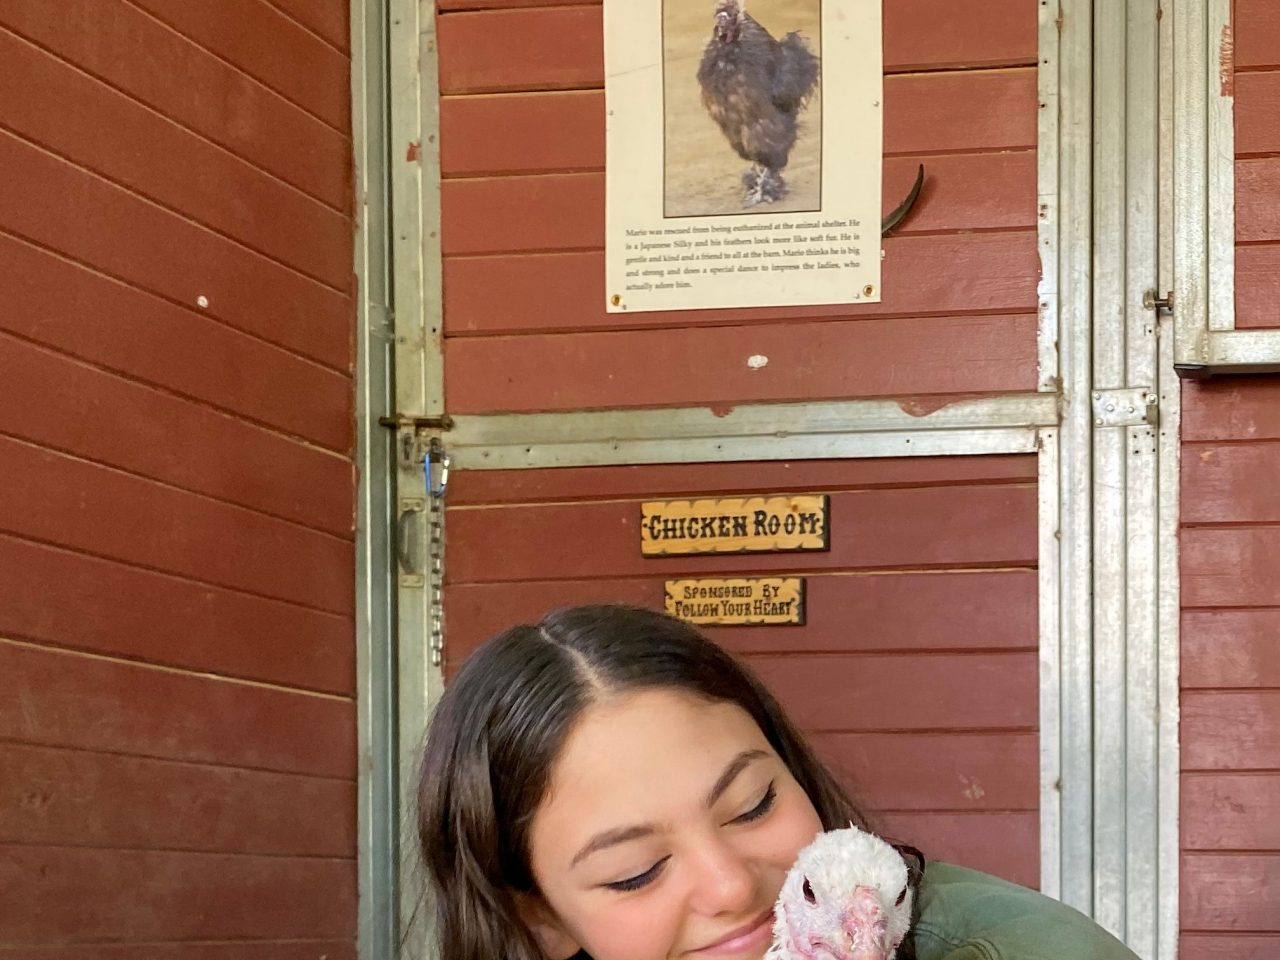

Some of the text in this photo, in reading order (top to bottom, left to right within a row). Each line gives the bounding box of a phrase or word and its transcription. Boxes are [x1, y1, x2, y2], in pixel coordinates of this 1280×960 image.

[664, 227, 690, 235] rescued
[711, 226, 731, 234] being
[733, 224, 772, 232] euthanized
[796, 221, 820, 229] animal
[640, 242, 671, 251] Japanese
[724, 238, 751, 246] feathers
[794, 235, 807, 243] like
[626, 256, 646, 265] gentle
[733, 251, 741, 259] all
[848, 247, 860, 255] big
[642, 269, 664, 277] strong
[710, 266, 734, 275] special
[772, 264, 799, 272] impress
[626, 283, 652, 291] actually
[648, 510, 817, 540] CHICKEN ROOM
[683, 584, 780, 600] SPONSORED BY
[675, 600, 719, 617] FOLLOW
[721, 600, 751, 616] YOUR
